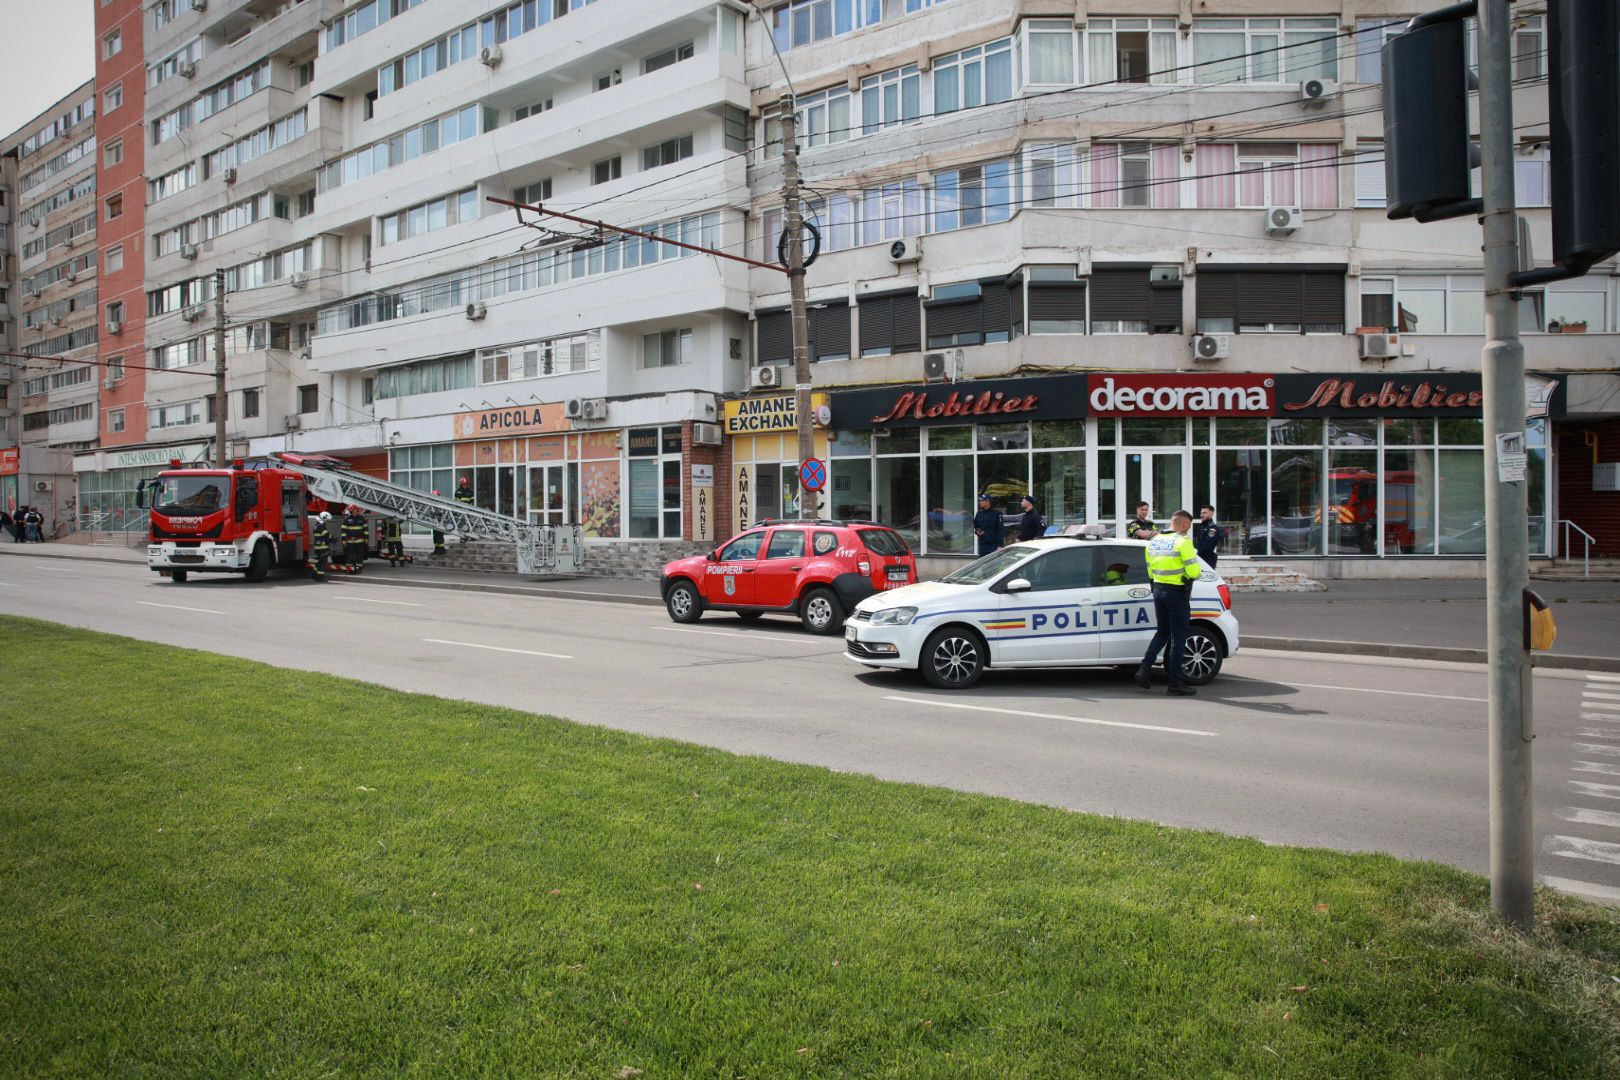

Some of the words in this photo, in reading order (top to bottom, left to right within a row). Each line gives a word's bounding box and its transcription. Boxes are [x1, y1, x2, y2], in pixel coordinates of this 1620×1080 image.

[738, 396, 796, 415] AMANE
[1090, 378, 1269, 411] decorama
[1283, 377, 1483, 411] Mobilier
[870, 390, 1039, 423] Mobilier
[480, 408, 542, 430] APICOLA
[729, 411, 817, 431] EXCHAN
[738, 467, 748, 532] AMANE
[699, 489, 707, 540] AMANET
[841, 548, 857, 558] 112
[706, 565, 744, 575] POMPIERII
[1032, 607, 1149, 630] POLITIA
